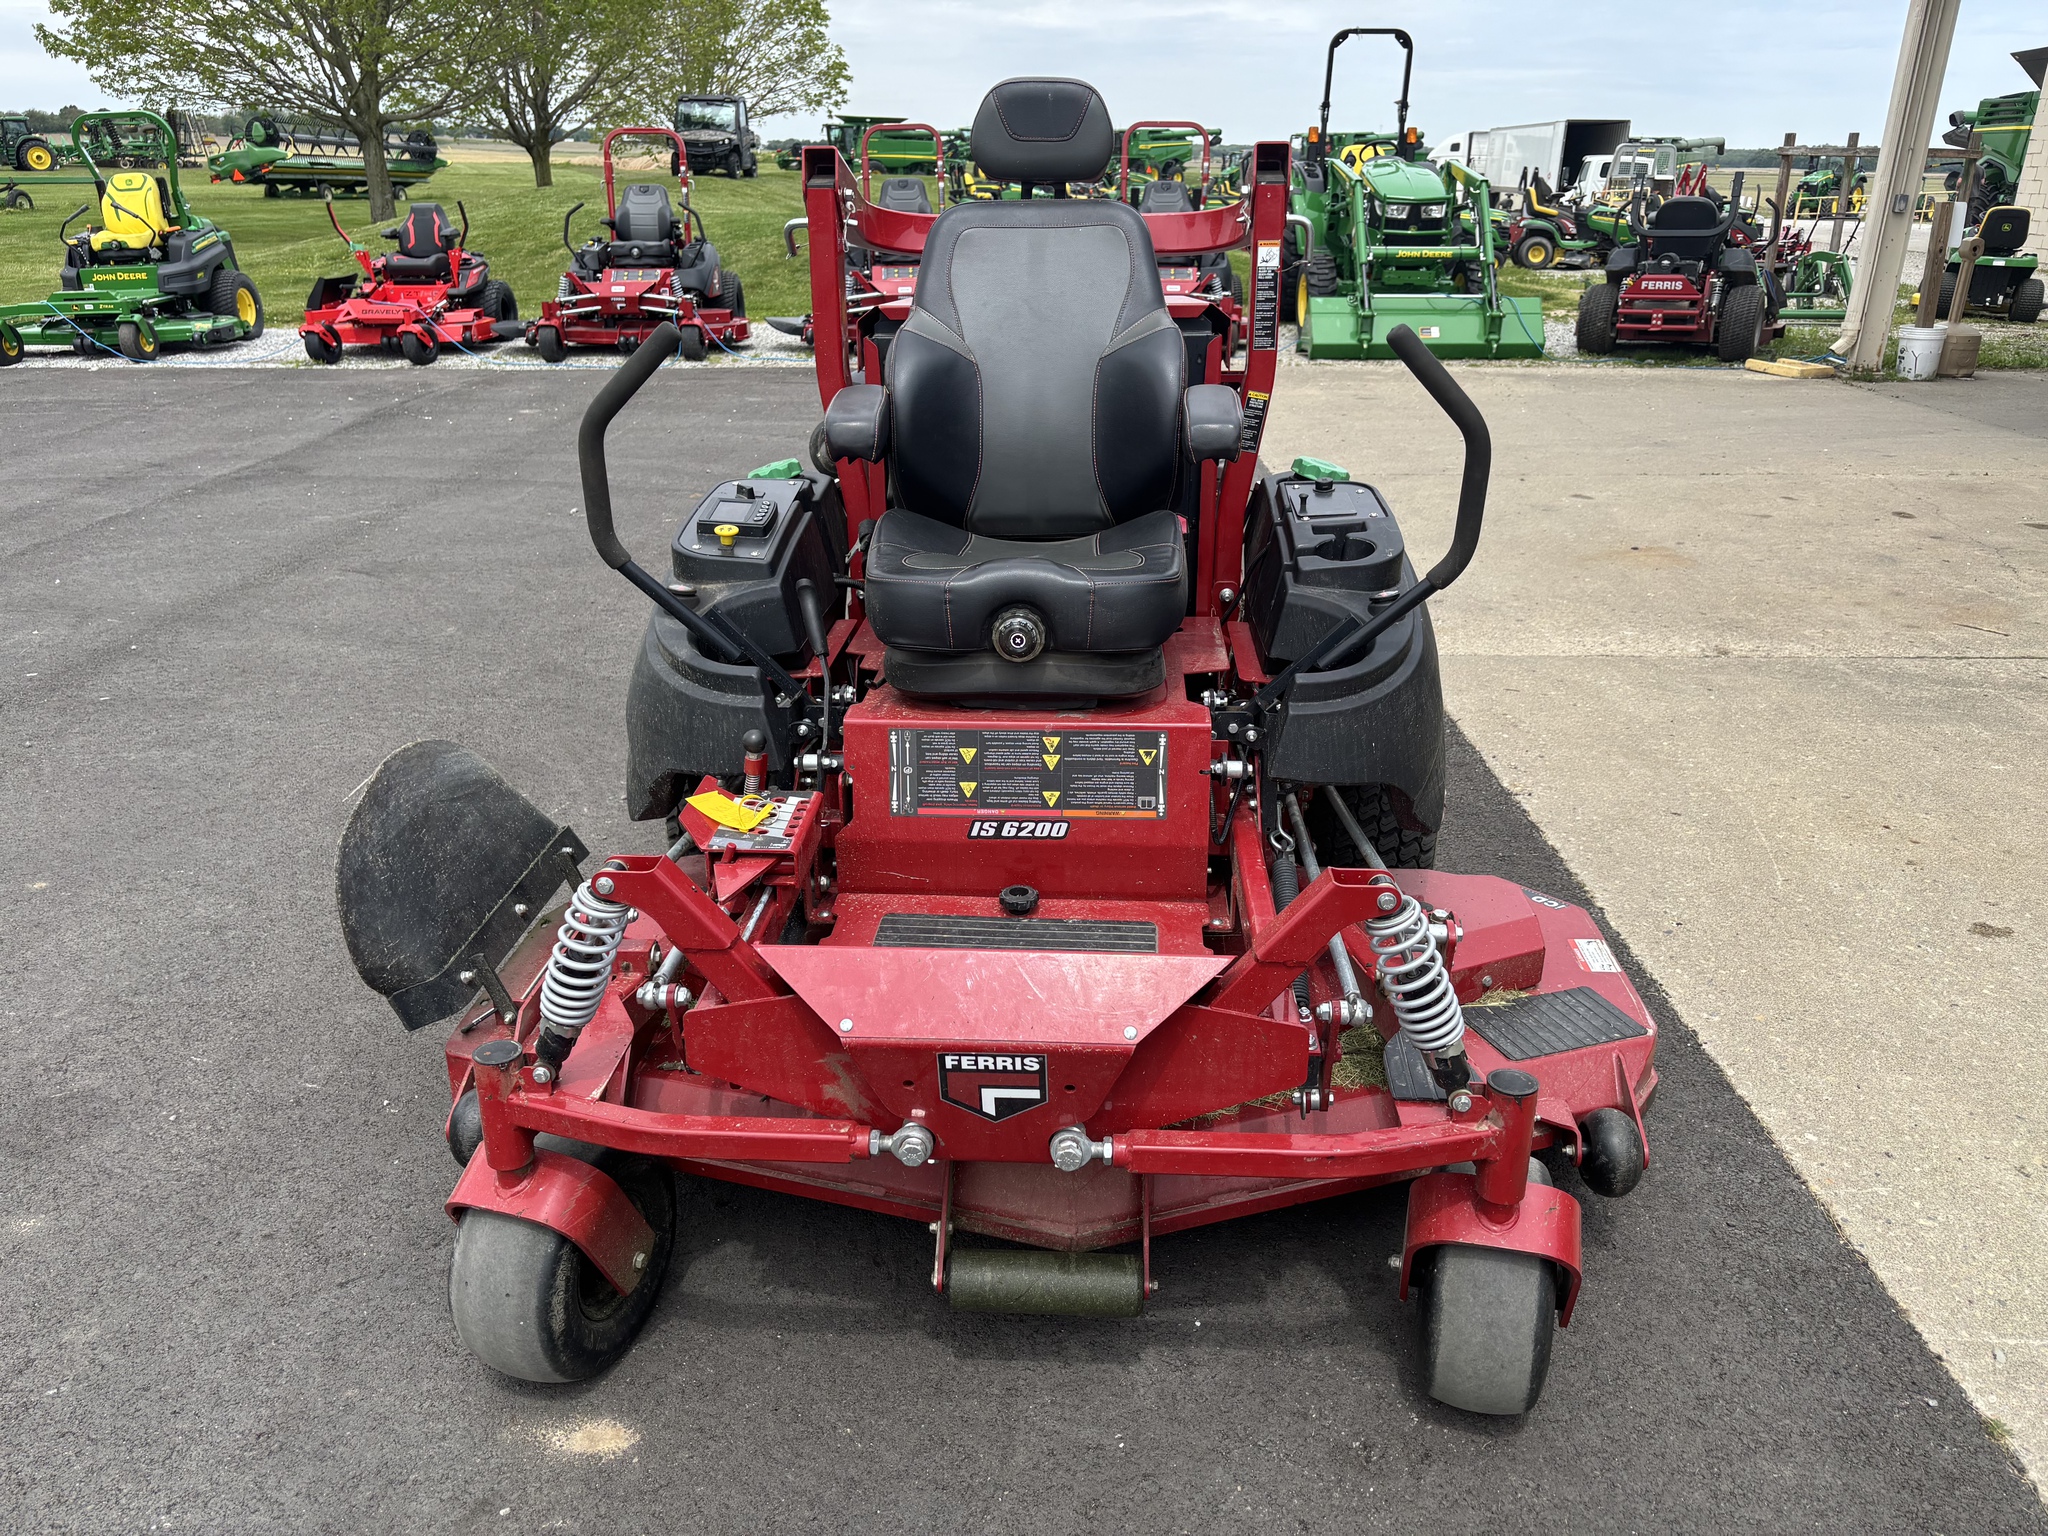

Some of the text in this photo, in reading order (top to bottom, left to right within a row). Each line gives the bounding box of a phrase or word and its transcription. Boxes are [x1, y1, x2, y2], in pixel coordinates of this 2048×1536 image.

[1395, 250, 1453, 258] JOHN DEERE
[92, 272, 148, 282] JOHN DEERE
[1641, 281, 1683, 290] FERRIS
[970, 821, 1069, 837] IS 6200
[944, 1055, 1040, 1071] FERRIS
